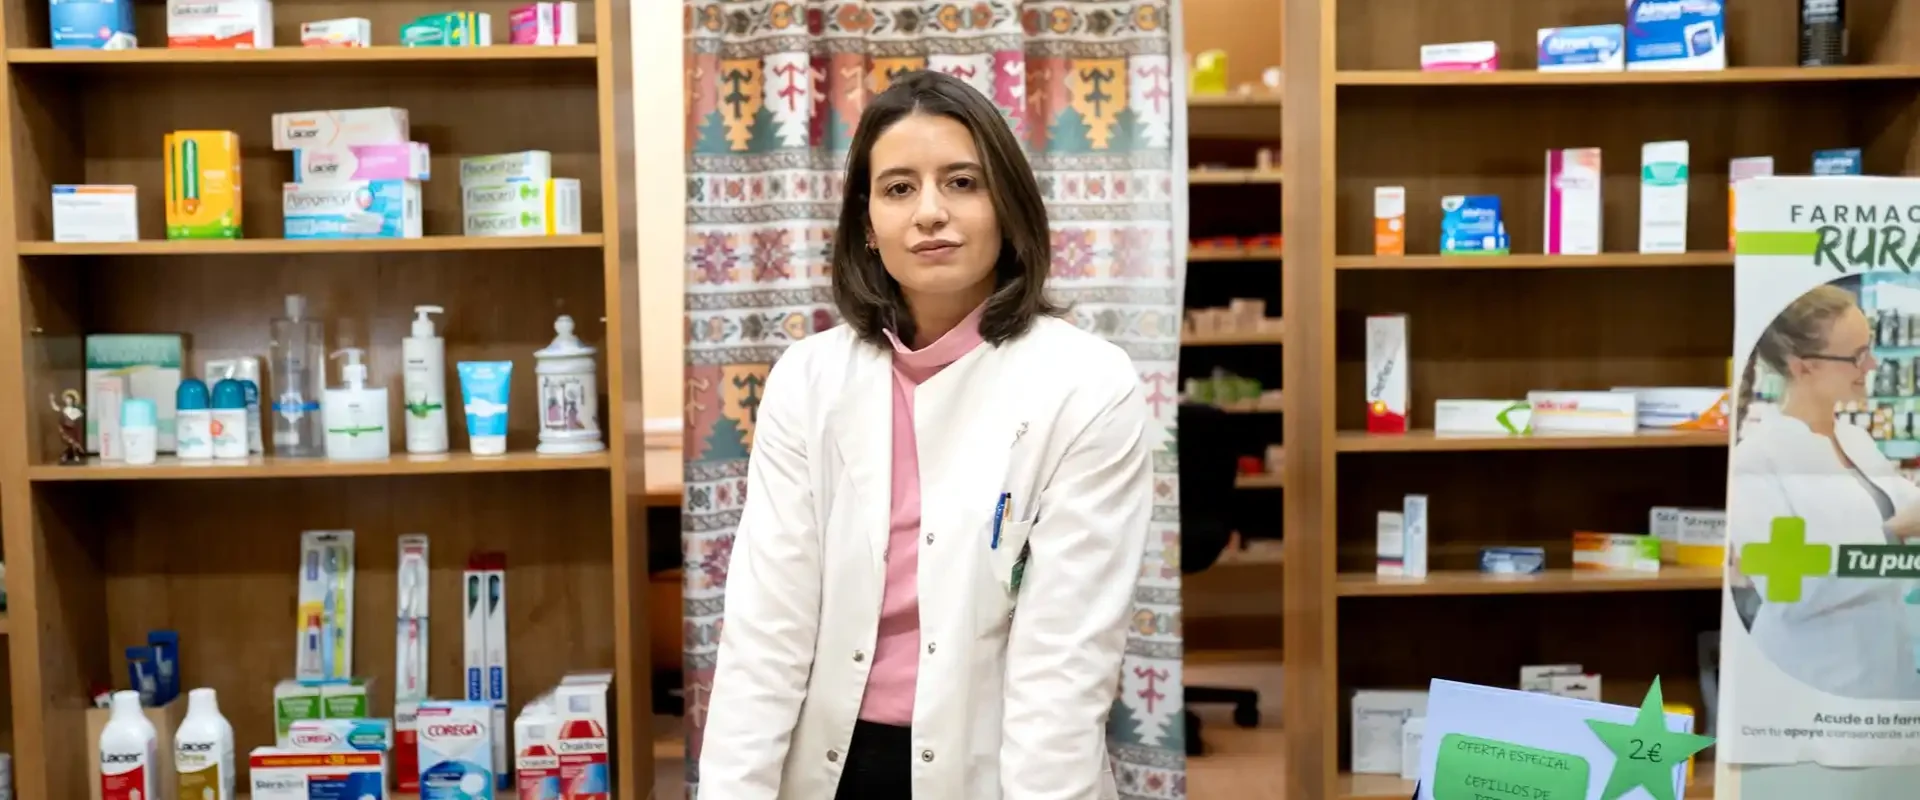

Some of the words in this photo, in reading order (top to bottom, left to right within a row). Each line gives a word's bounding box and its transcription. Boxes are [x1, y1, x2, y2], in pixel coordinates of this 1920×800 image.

[286, 127, 319, 140] Lacer
[308, 162, 339, 174] Lacer
[1790, 204, 1920, 223] FARMAC
[1847, 549, 1877, 570] Tu
[1813, 712, 1862, 724] Acude
[1864, 715, 1874, 725] a
[1877, 713, 1891, 725] la
[427, 723, 479, 738] COREGA
[1741, 725, 1767, 737] Con
[1769, 727, 1781, 737] tu
[1783, 728, 1824, 740] apoyo
[176, 741, 216, 752] Lacer
[560, 740, 605, 752] Oraldine
[1629, 738, 1663, 763] 2€
[100, 751, 143, 763] Lacer
[1457, 740, 1506, 759] OFERTA
[1509, 750, 1571, 770] ESPECIAL
[1464, 773, 1531, 798] CEPILLOS
[1533, 787, 1552, 800] DE
